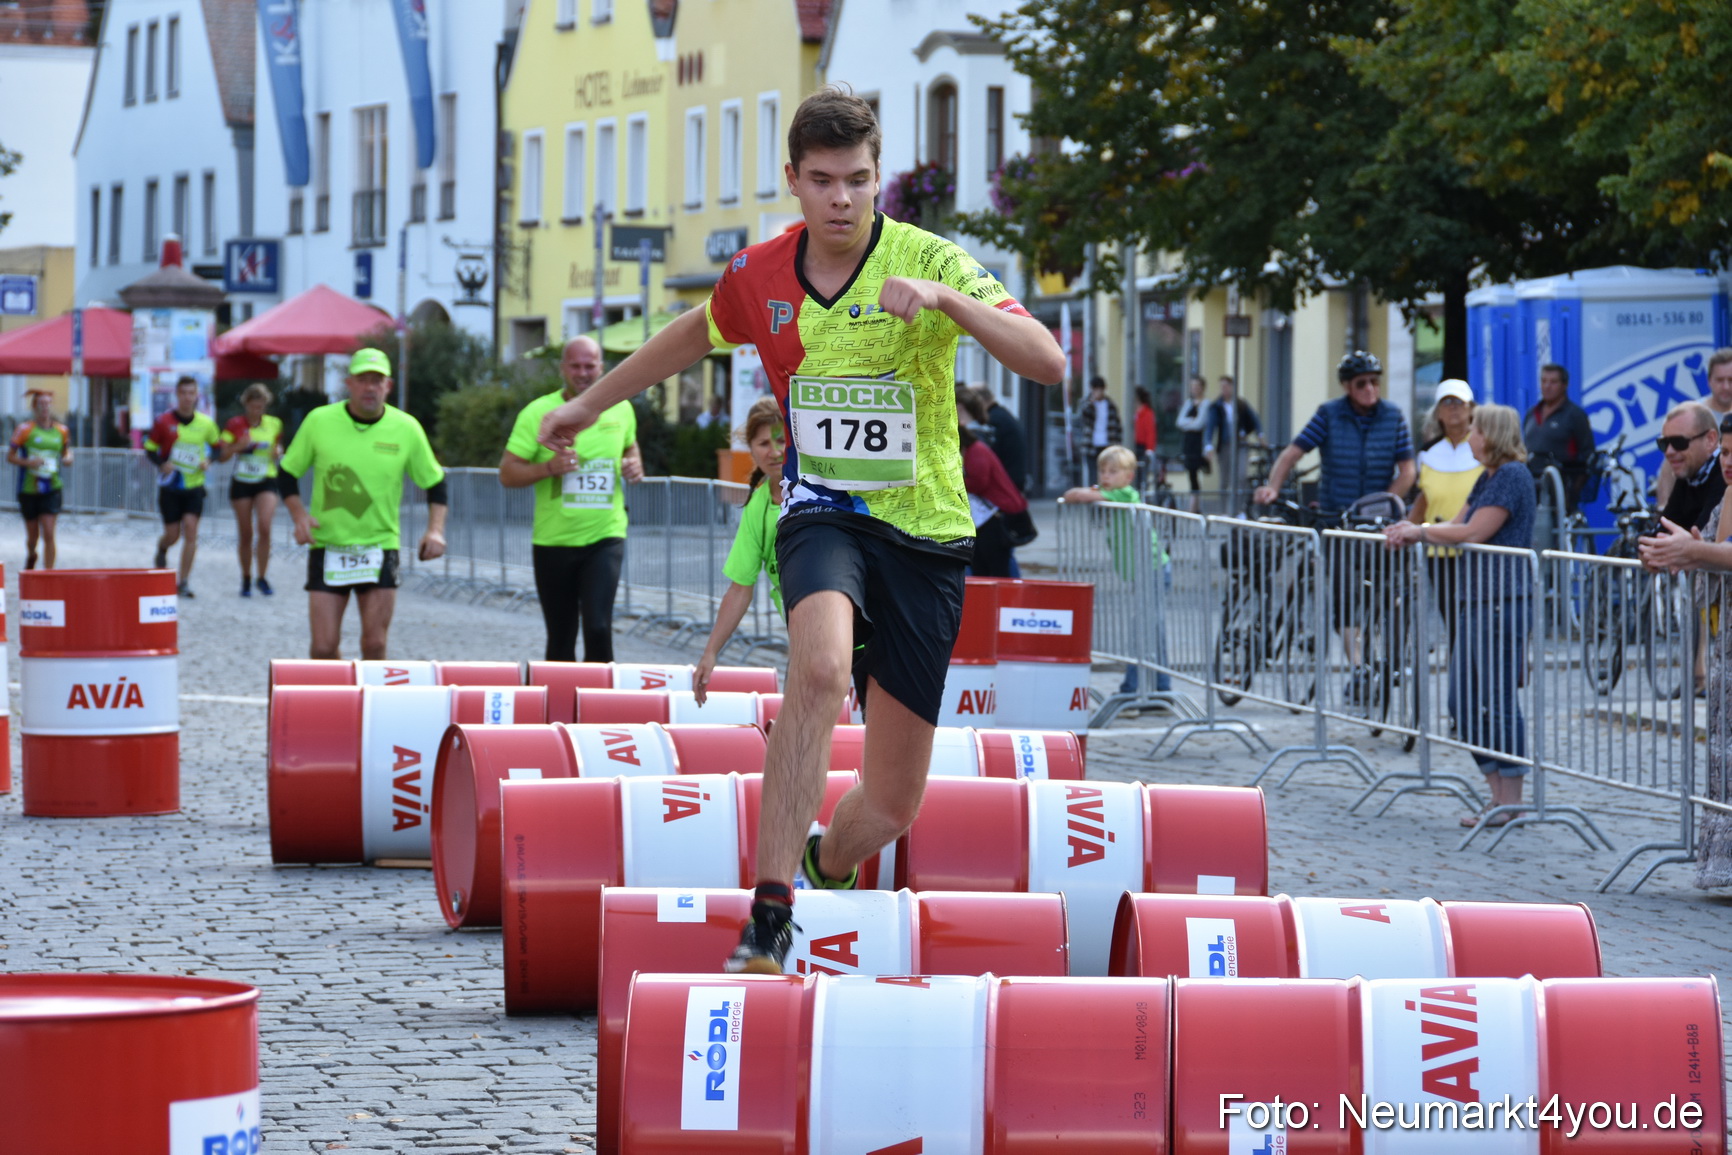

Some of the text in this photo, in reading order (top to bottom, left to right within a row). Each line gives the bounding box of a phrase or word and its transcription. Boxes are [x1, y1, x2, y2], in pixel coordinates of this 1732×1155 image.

[1617, 312, 1650, 326] 08141
[1663, 311, 1685, 325] 536
[1689, 311, 1704, 324] 80
[800, 382, 904, 410] BOCK
[816, 418, 888, 452] 178
[576, 475, 607, 490] 152
[340, 554, 370, 569] 154
[731, 1001, 742, 1043] energie
[1686, 1023, 1702, 1084] 12414-B&B
[1134, 1092, 1147, 1120] 323
